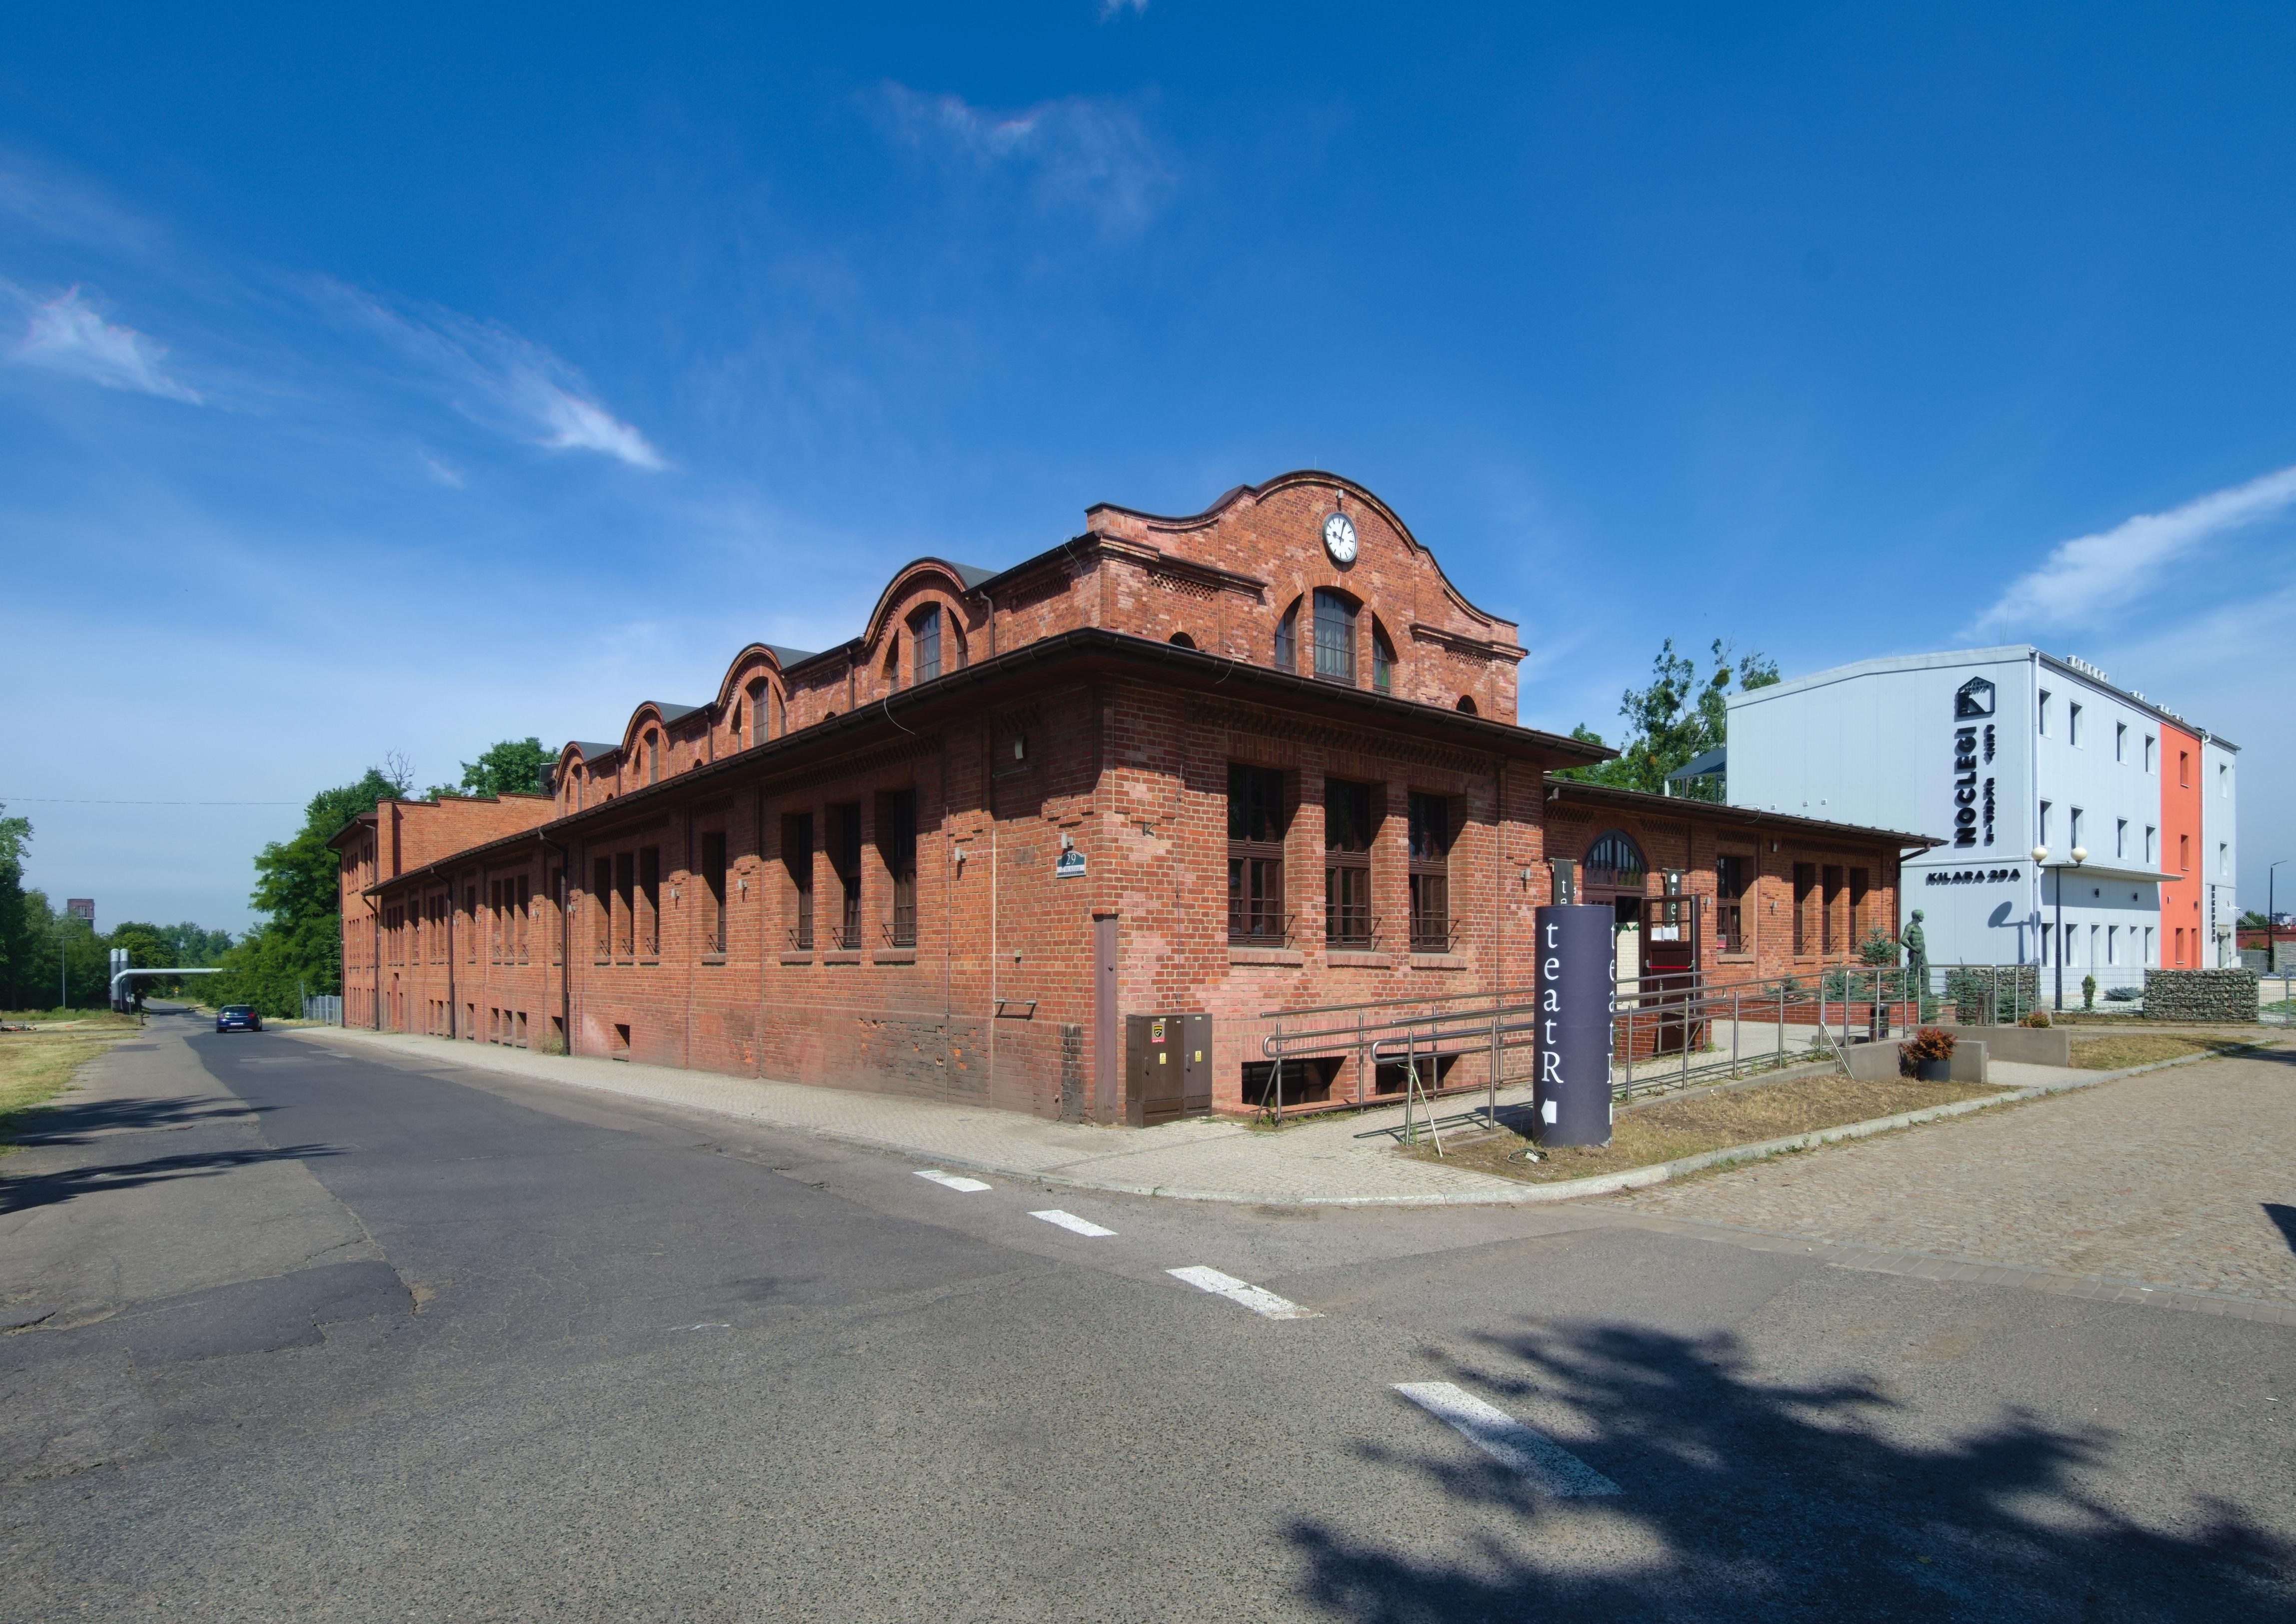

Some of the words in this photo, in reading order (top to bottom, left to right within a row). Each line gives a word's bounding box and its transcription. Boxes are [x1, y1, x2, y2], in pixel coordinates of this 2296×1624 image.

[1986, 724, 1995, 761] PRZY
[1957, 726, 1977, 844] NOCLEGI
[1986, 778, 1995, 842] SKARPIE
[1066, 853, 1076, 865] 29
[1928, 870, 1986, 882] KILARA
[1541, 923, 1564, 1084] teatR
